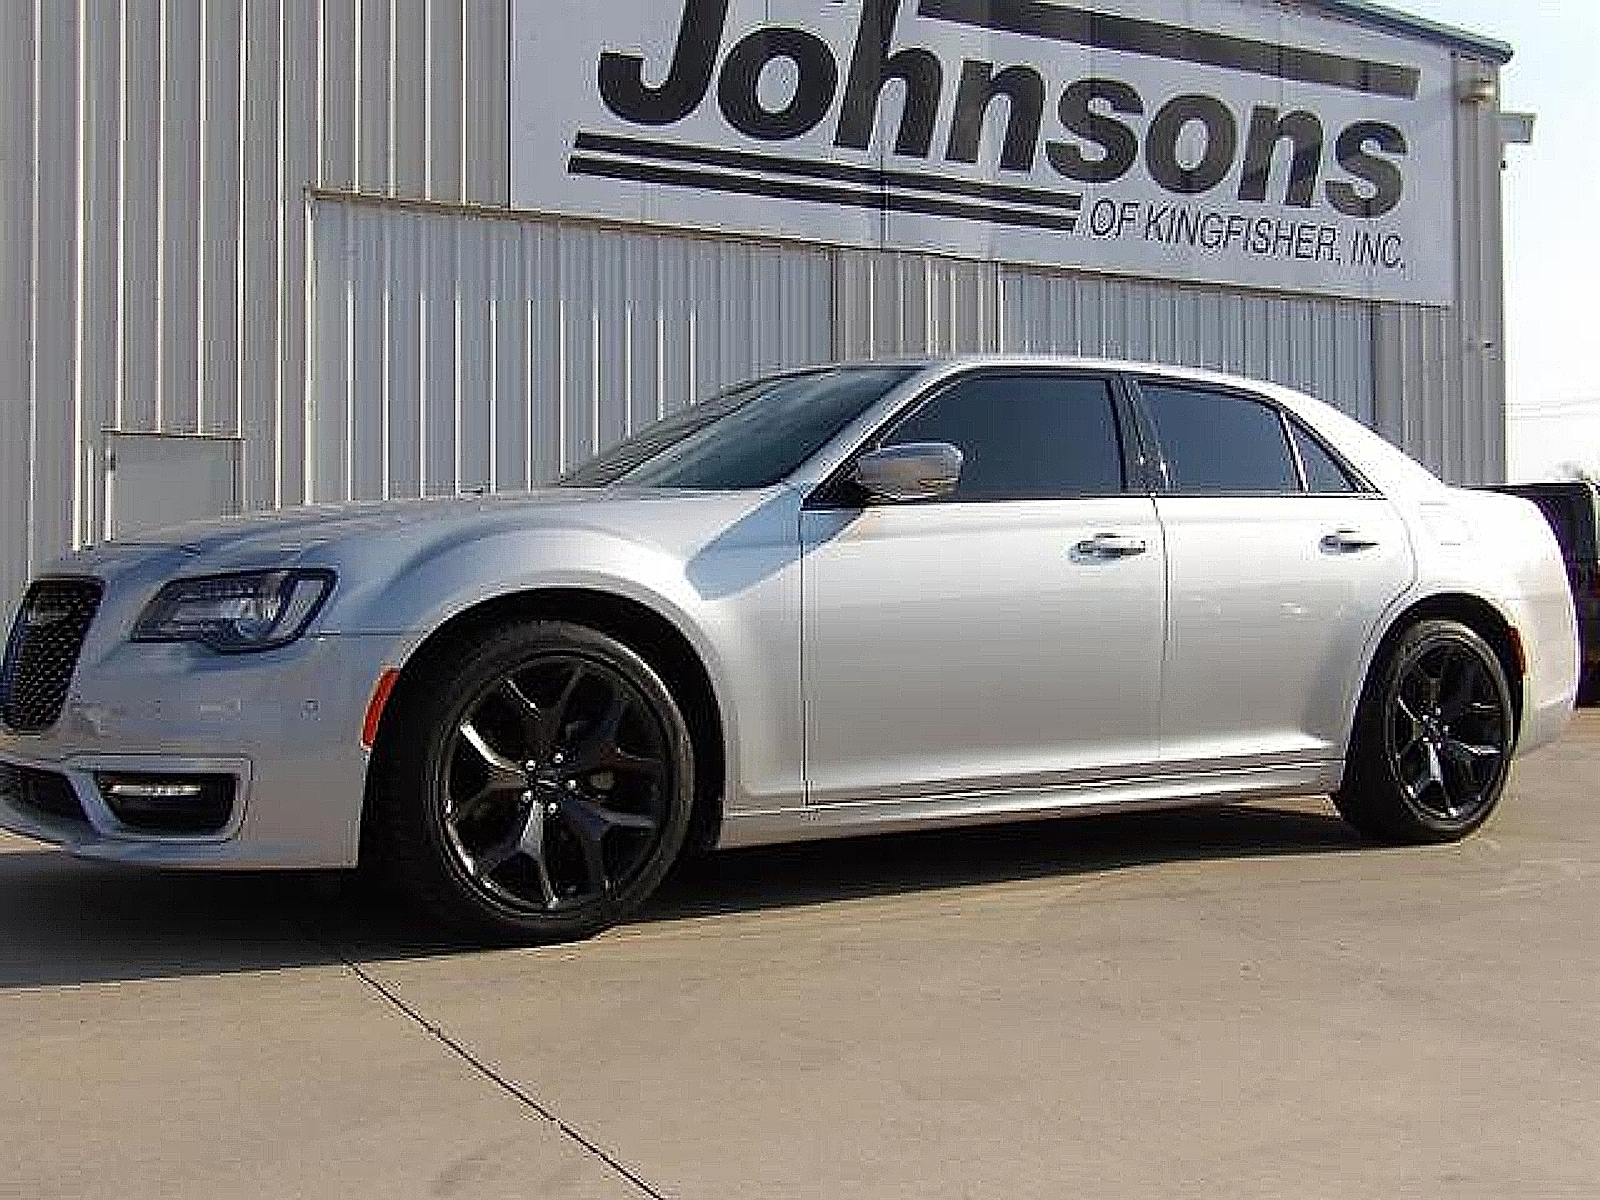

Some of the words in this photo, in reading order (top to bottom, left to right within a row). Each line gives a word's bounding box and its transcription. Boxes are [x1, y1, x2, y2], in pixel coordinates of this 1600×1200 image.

[598, 0, 1407, 218] Johnsons
[1091, 198, 1140, 238] OF
[1350, 228, 1406, 268] INC.
